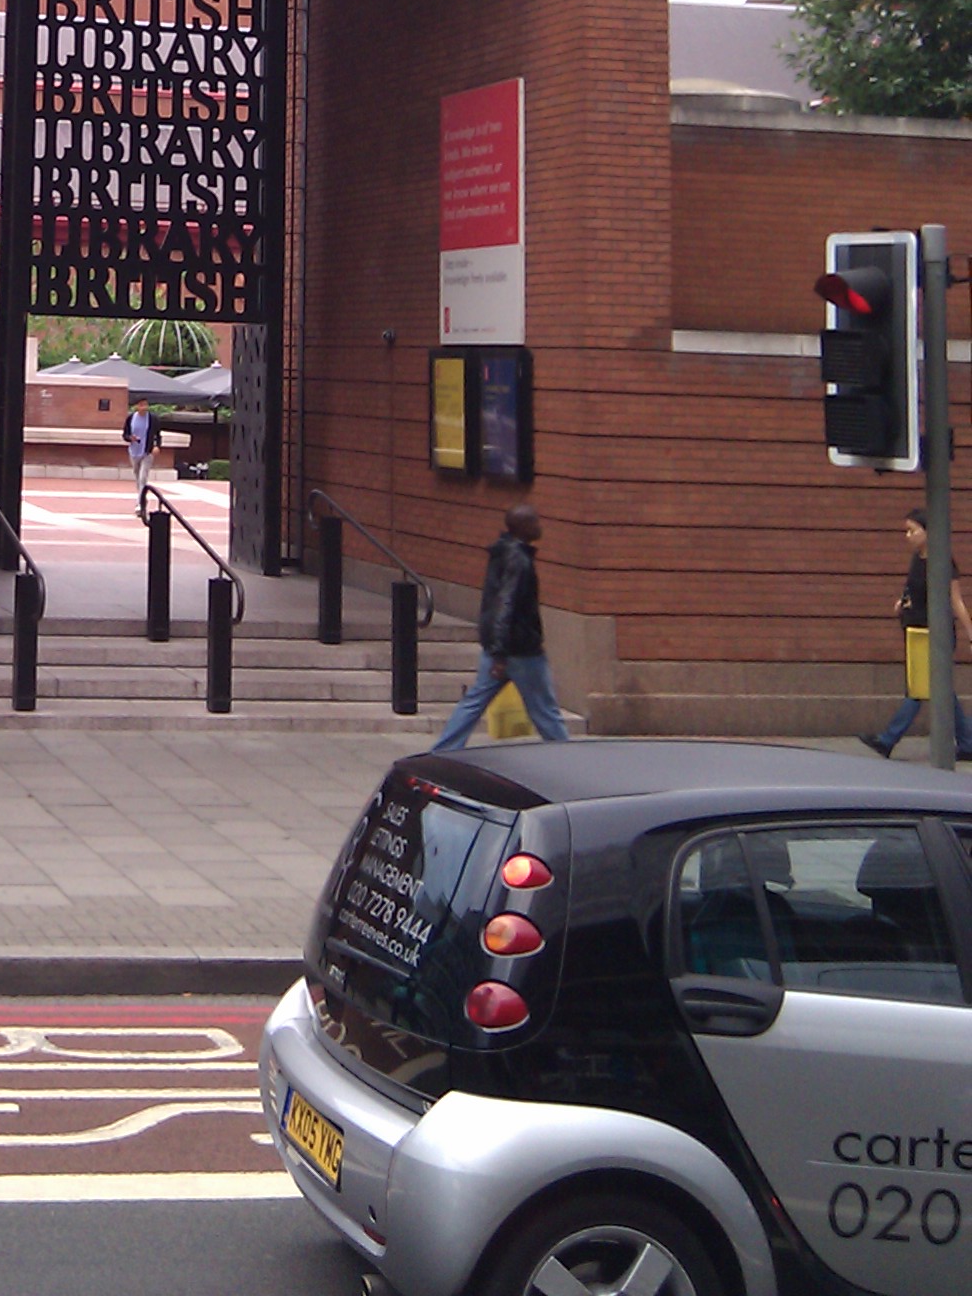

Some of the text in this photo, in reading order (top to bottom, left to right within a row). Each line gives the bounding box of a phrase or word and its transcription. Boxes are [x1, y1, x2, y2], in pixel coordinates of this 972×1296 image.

[42, 24, 264, 77] LIBRARY
[41, 71, 264, 122] BRITISH
[40, 118, 264, 169] LIBRARY
[38, 165, 262, 216] BRITISH
[37, 215, 262, 264] LIBRARY
[36, 264, 261, 314] BRITISH
[360, 853, 425, 898] MANAGEMENT
[364, 890, 397, 924] 7278
[393, 907, 433, 945] 9444
[829, 1181, 961, 1245] 020
